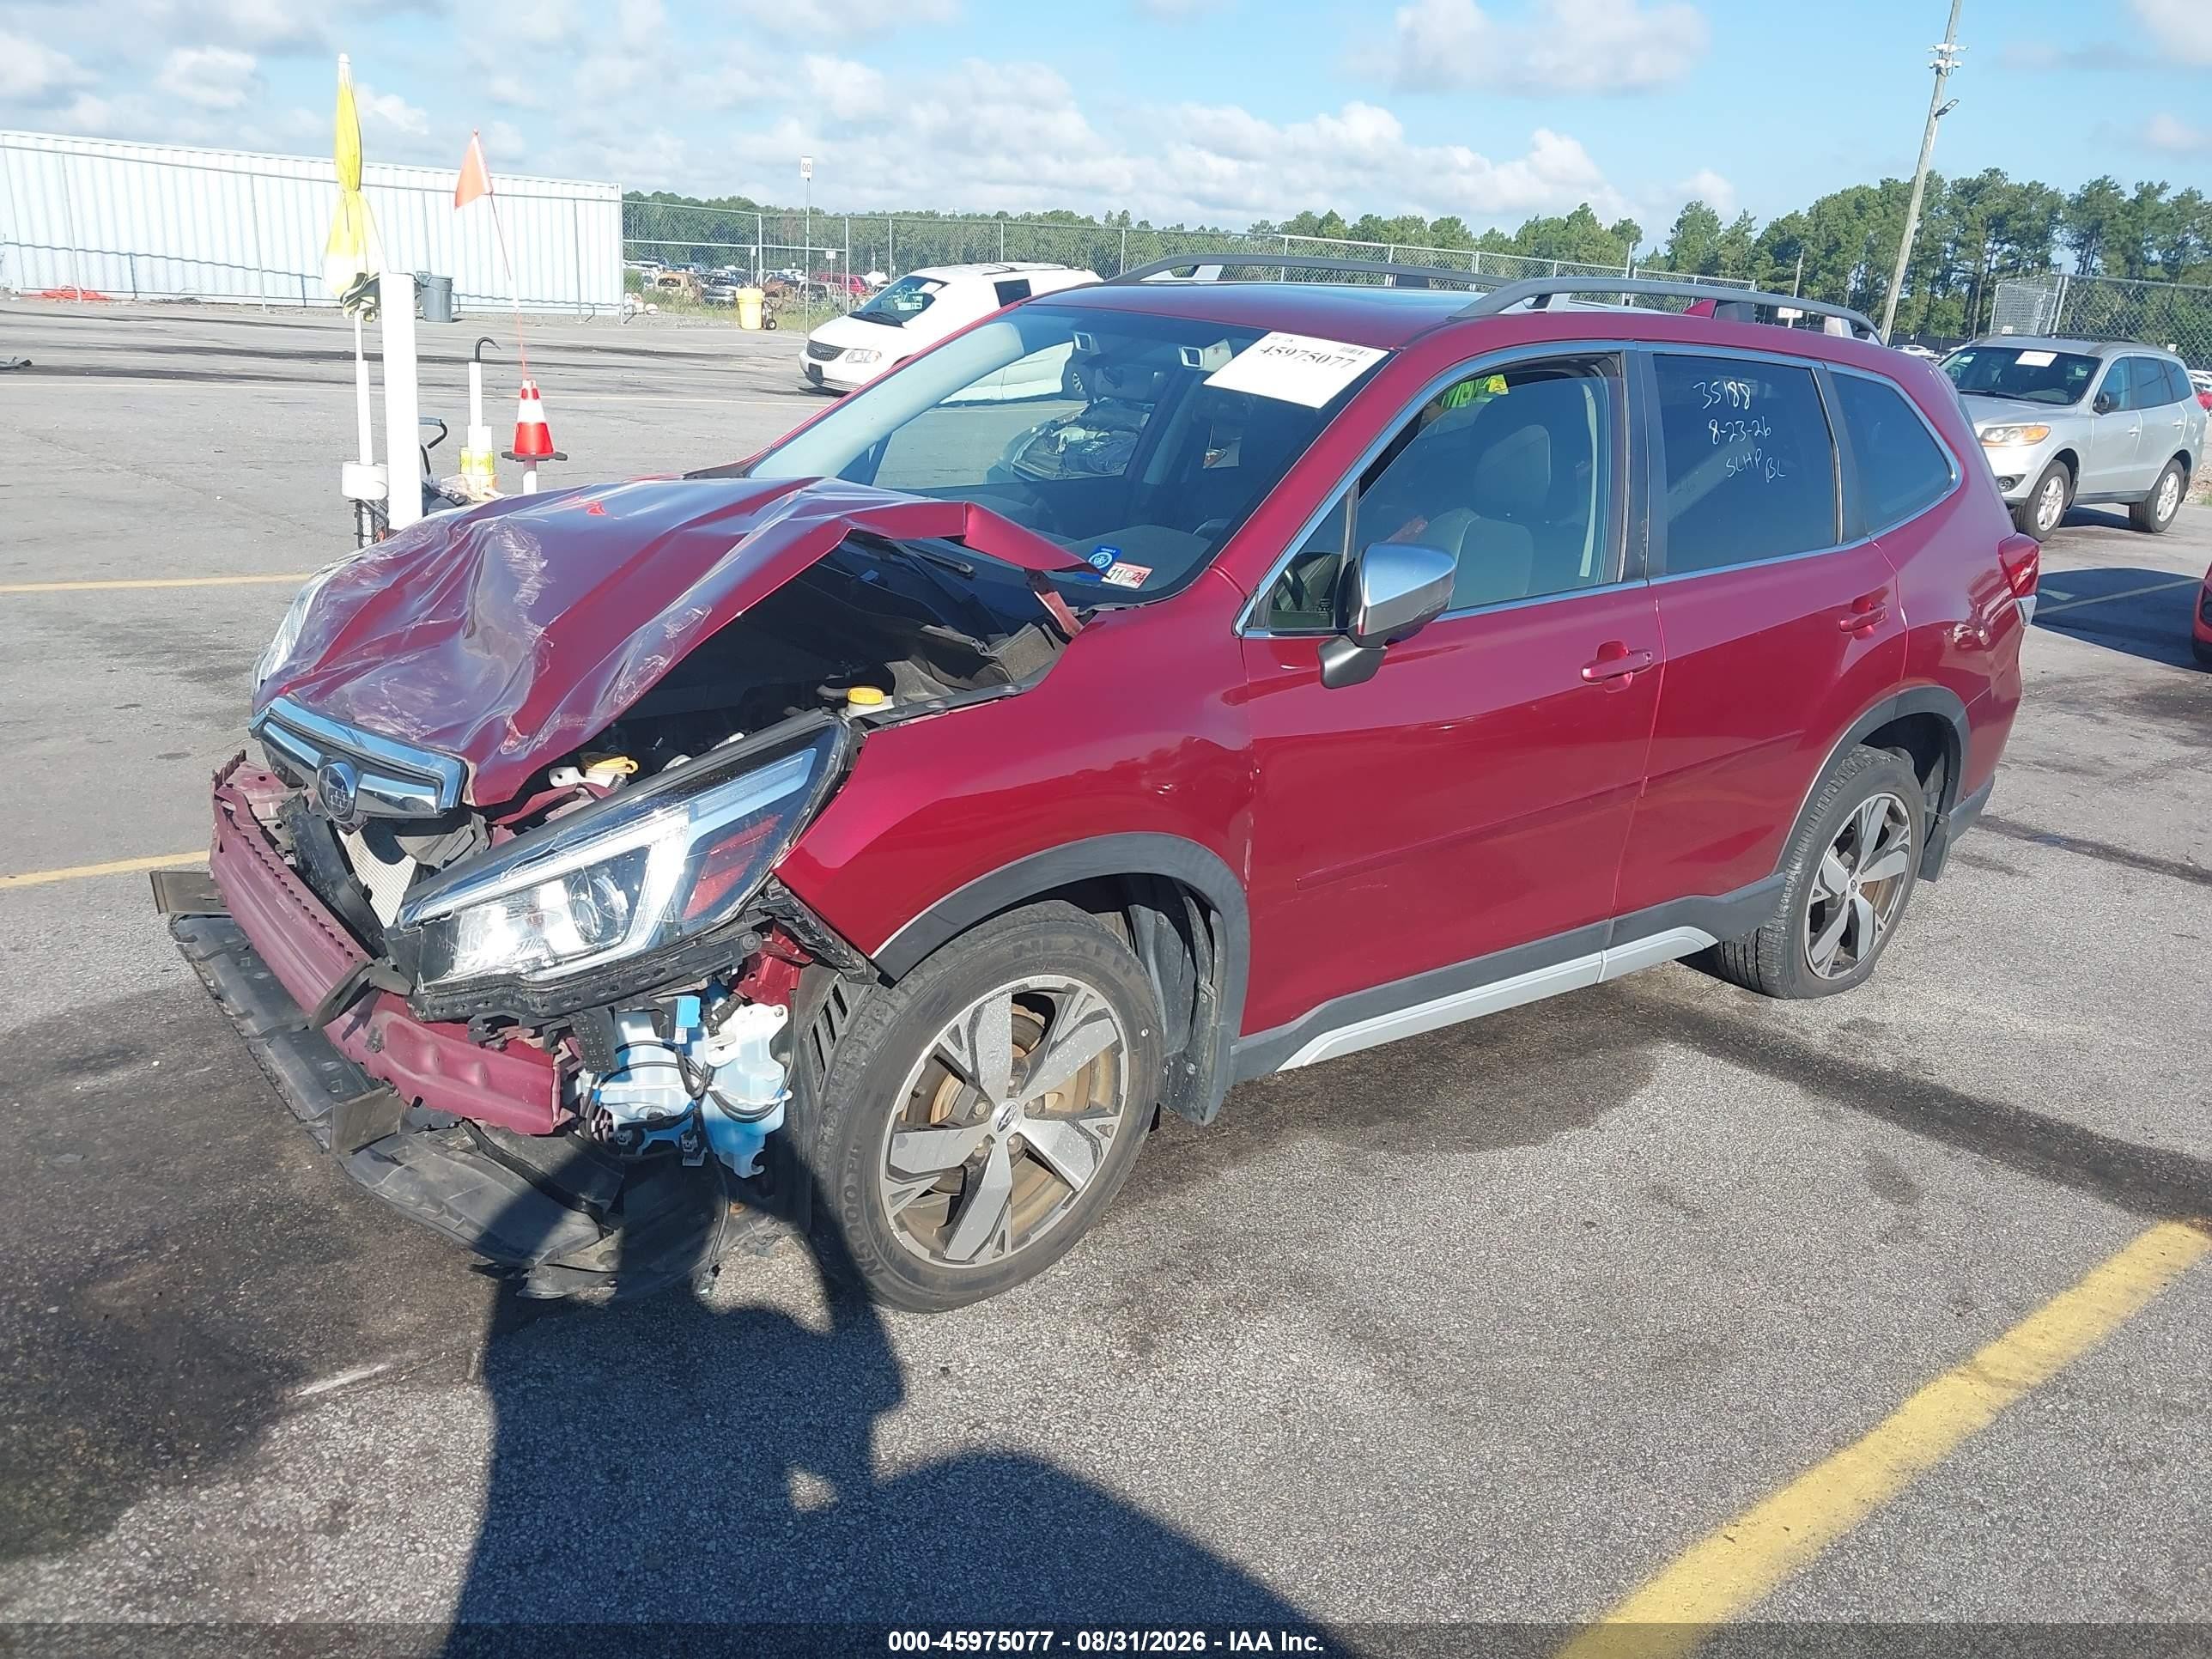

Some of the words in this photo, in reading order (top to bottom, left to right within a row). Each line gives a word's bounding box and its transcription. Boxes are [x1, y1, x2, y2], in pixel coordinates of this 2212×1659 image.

[1260, 345, 1358, 369] 45975077
[1692, 381, 1752, 410] 35188
[1708, 416, 1771, 445] 8-23-26
